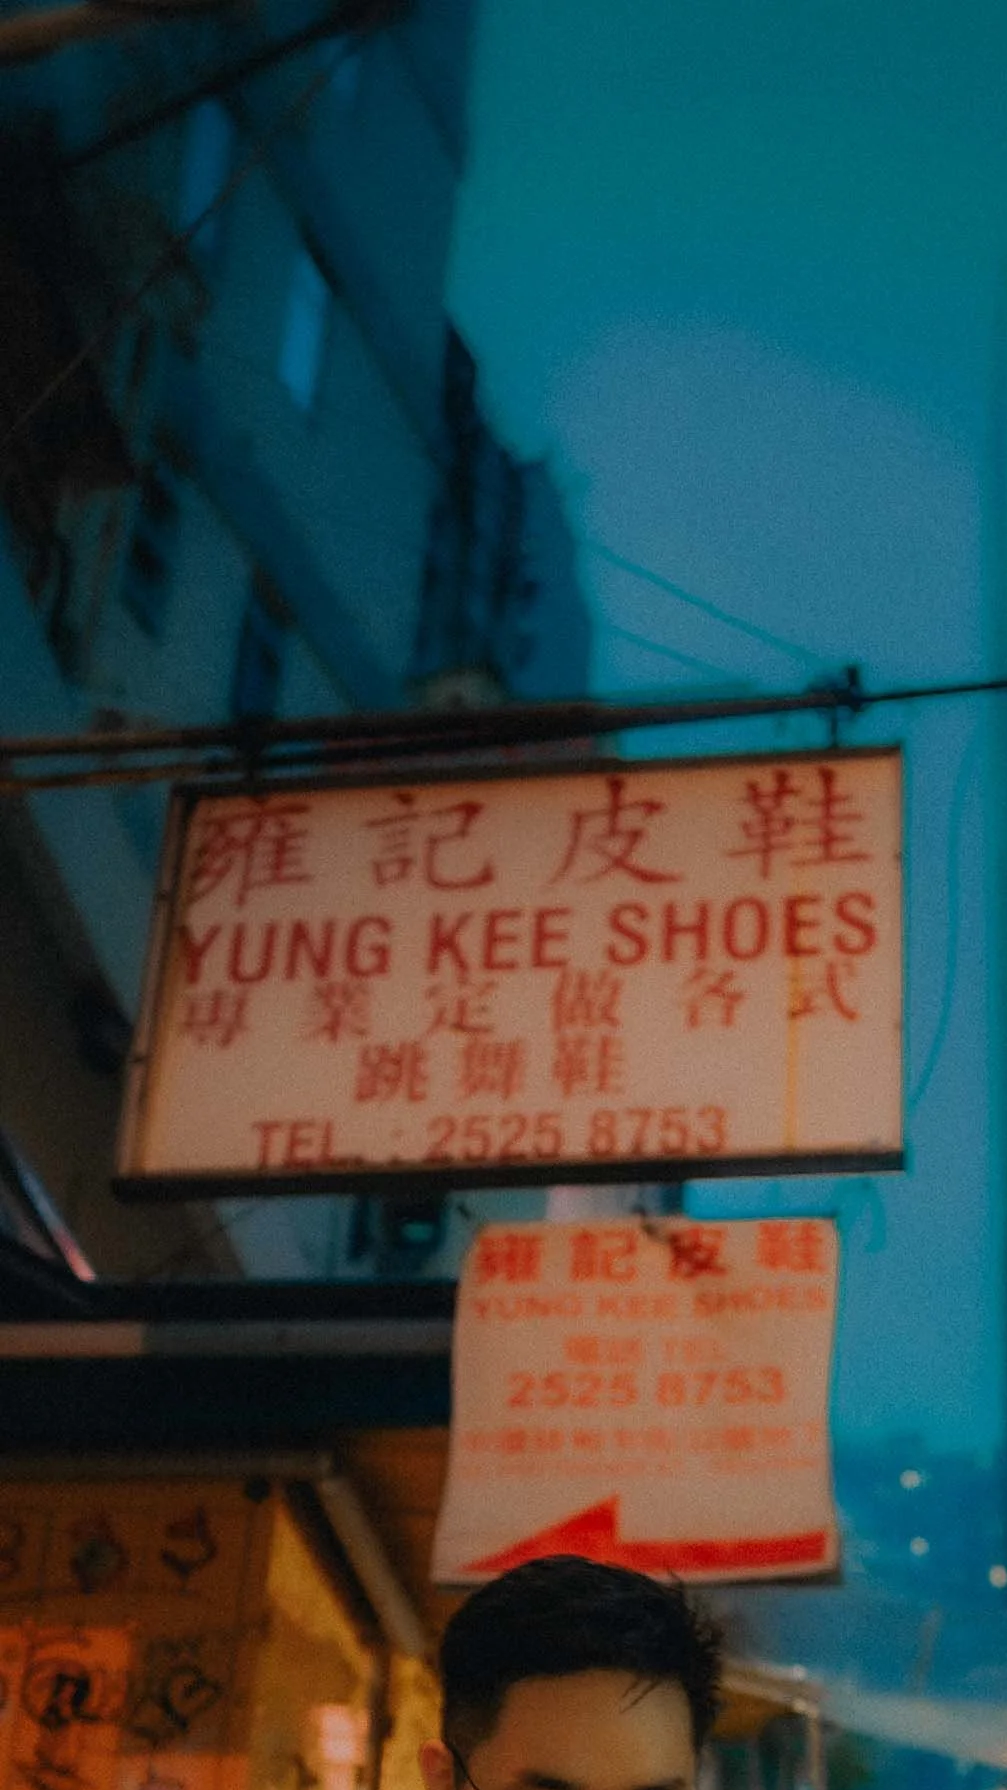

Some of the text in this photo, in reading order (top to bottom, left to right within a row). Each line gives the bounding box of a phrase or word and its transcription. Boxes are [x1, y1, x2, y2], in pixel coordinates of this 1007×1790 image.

[180, 891, 877, 984] YUNG KEE SHOES
[354, 1036, 625, 1104] 跳舞鞋
[425, 1111, 563, 1164] 2525
[588, 1105, 727, 1158] 8753
[473, 1284, 827, 1321] YUNG KEE SHOES
[507, 1364, 787, 1409] 2525 8753
